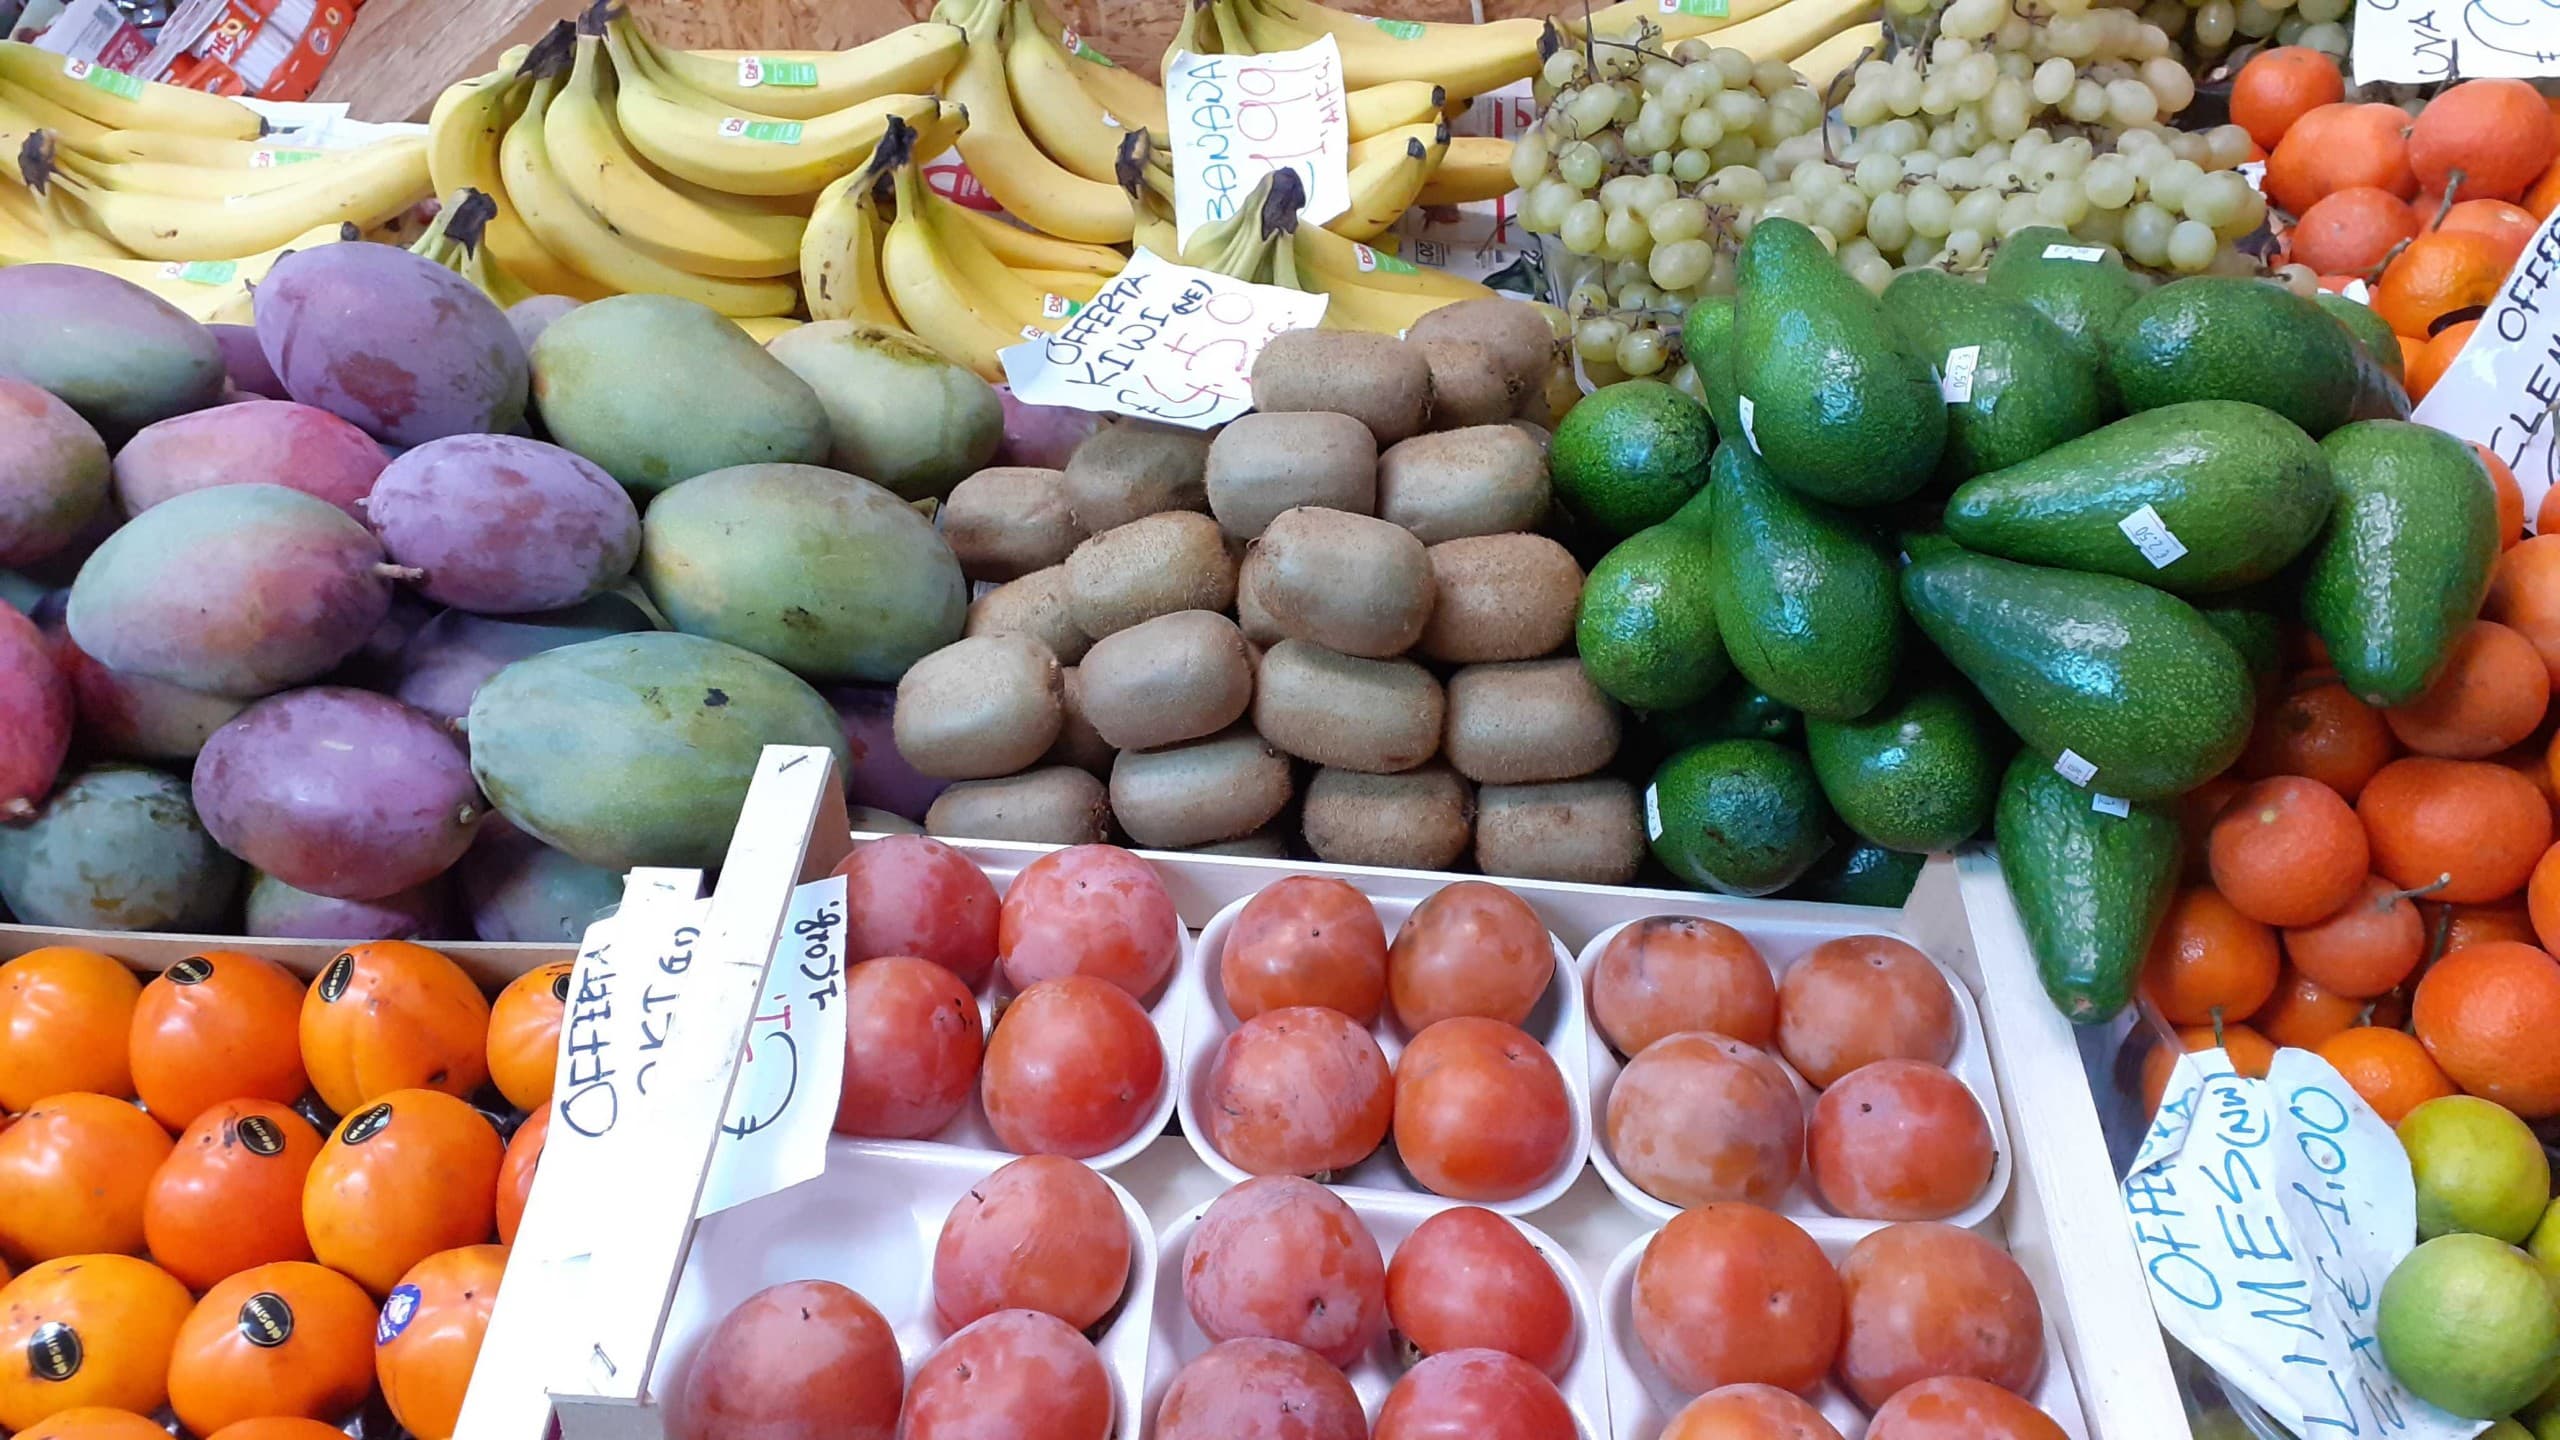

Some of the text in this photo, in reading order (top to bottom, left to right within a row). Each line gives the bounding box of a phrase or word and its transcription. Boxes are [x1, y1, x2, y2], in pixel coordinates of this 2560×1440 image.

[2408, 10, 2450, 74] UVA
[1046, 274, 1151, 365] OFFERTA
[1172, 280, 1213, 315] (NE)
[1066, 307, 1169, 386] KIWI
[561, 944, 617, 1138] OFFERTA
